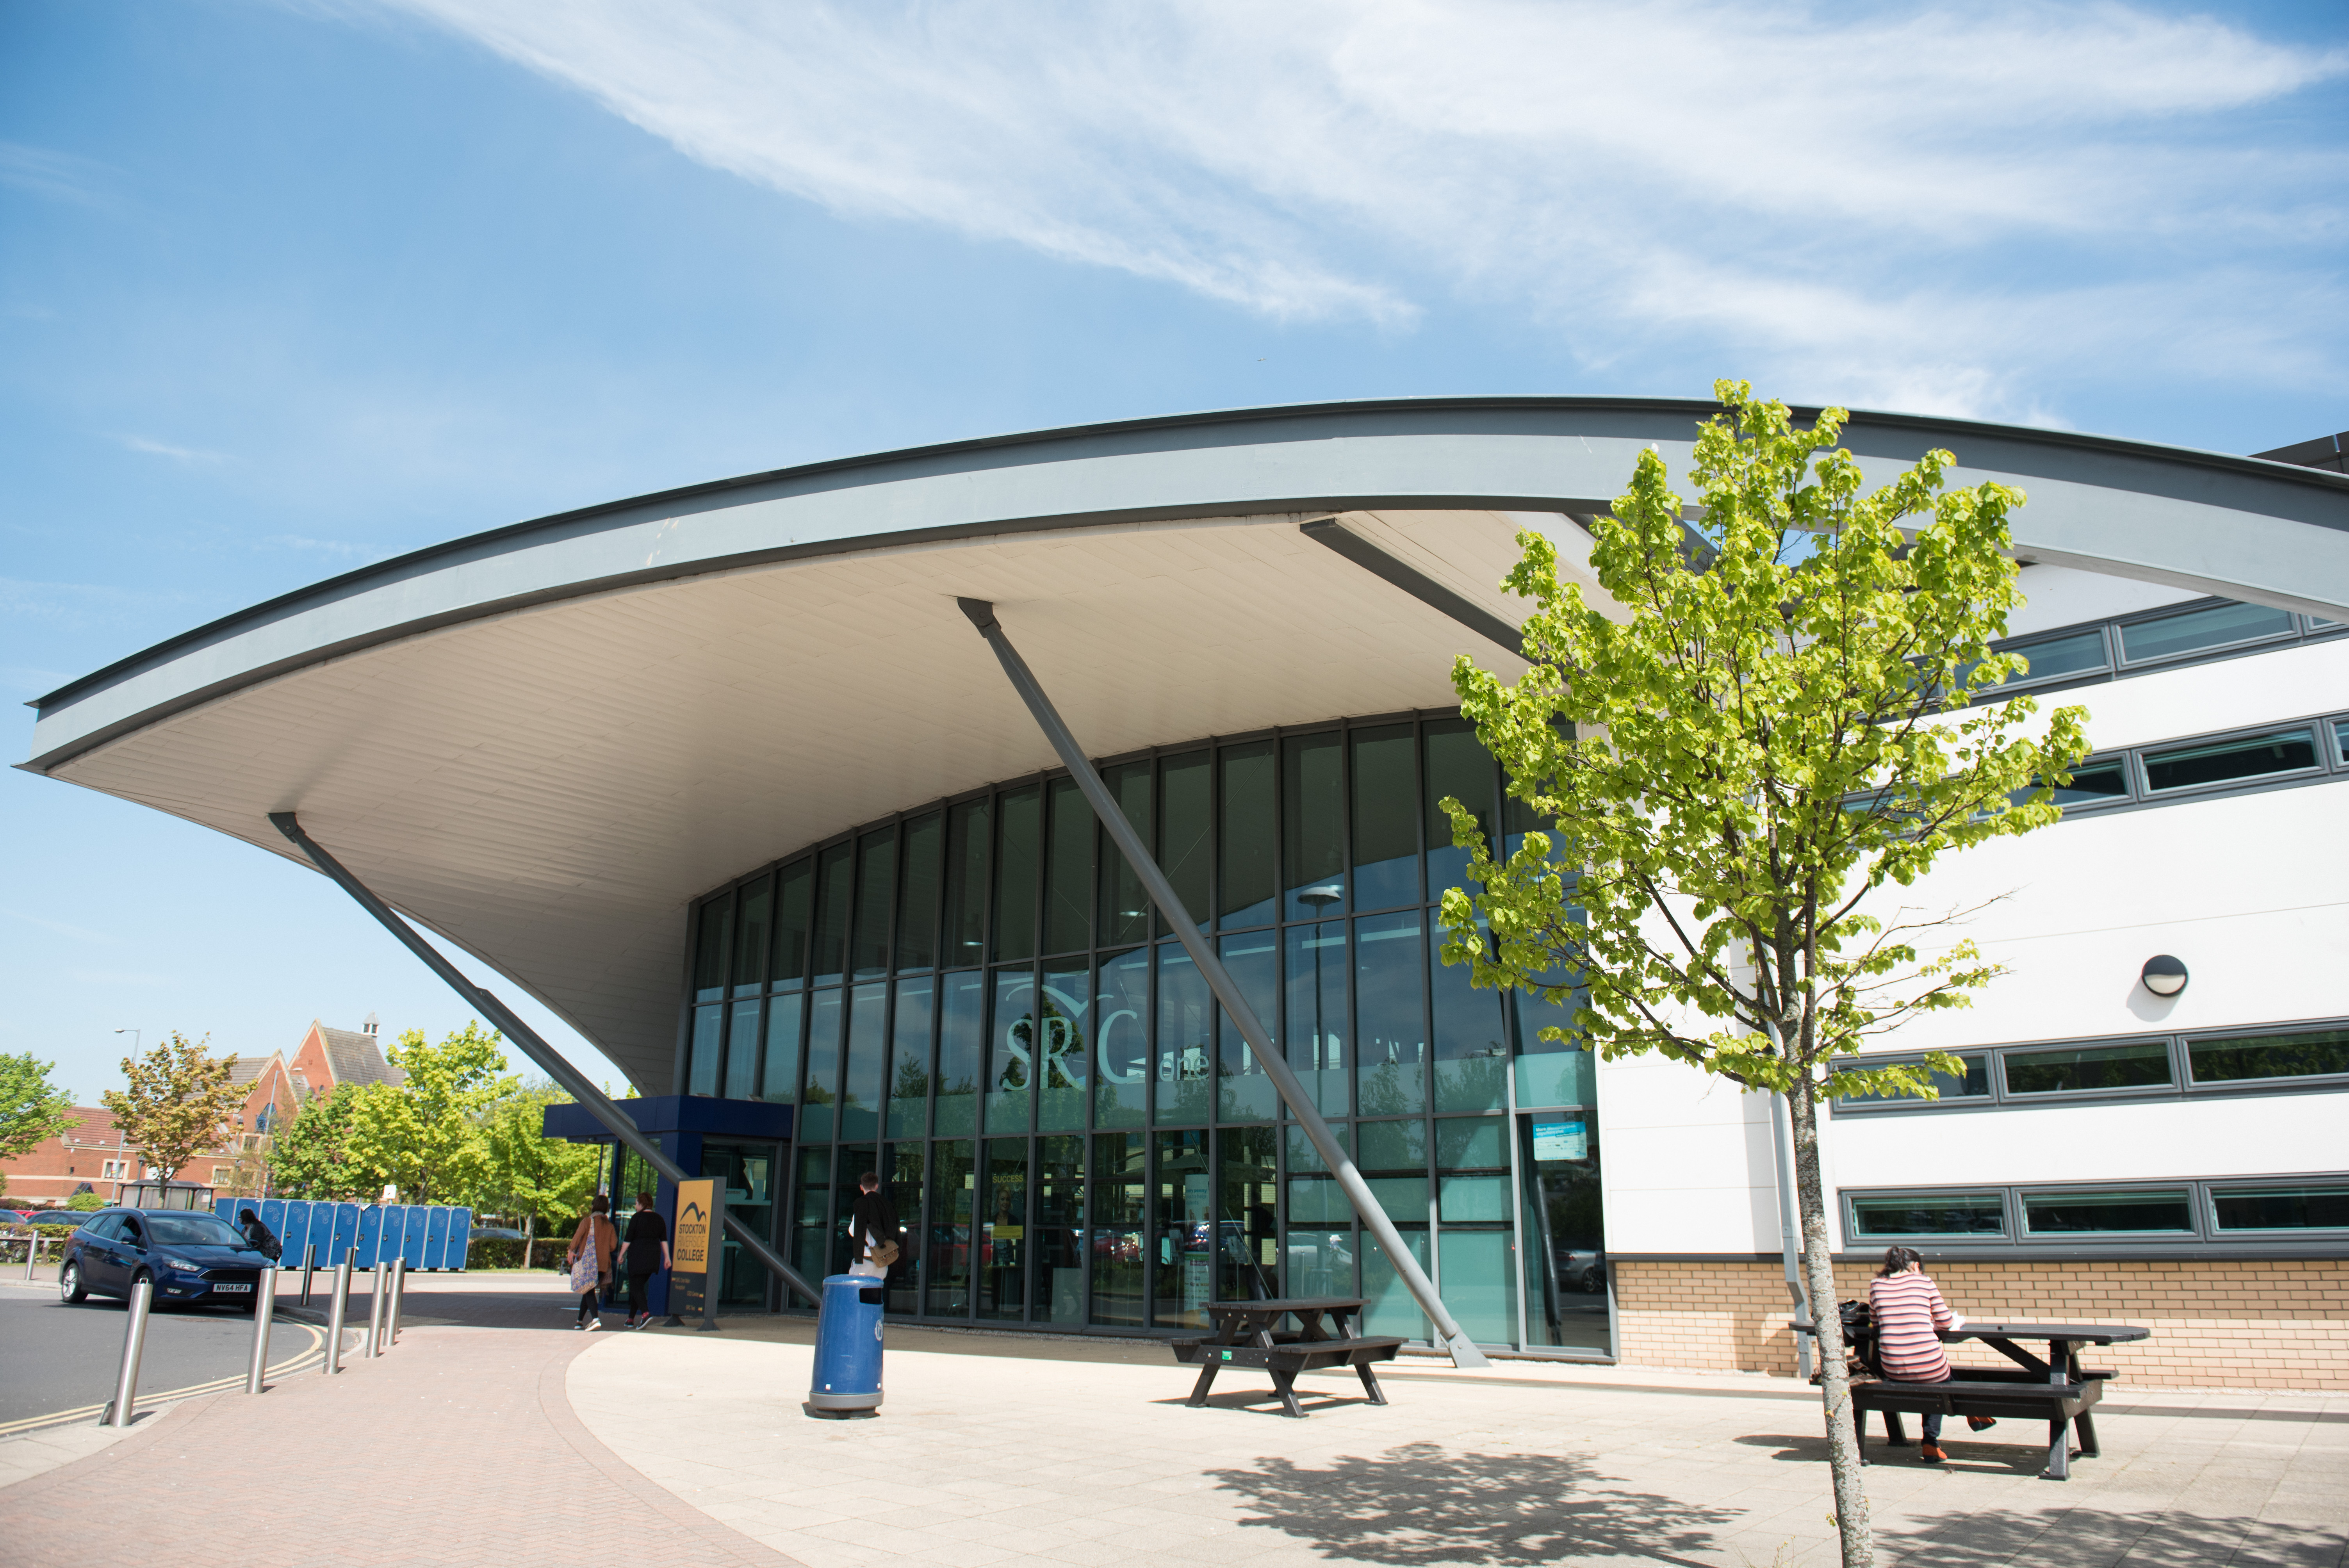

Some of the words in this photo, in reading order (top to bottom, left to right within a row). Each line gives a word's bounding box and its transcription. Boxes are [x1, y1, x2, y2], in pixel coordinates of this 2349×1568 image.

[1003, 1010, 1140, 1092] SRC
[1159, 1055, 1209, 1081] one
[993, 1174, 1023, 1183] SUCCESS
[679, 1224, 706, 1234] STOCKTON
[678, 1235, 705, 1248] RIVERSIDE
[677, 1249, 704, 1262] COLLEGE
